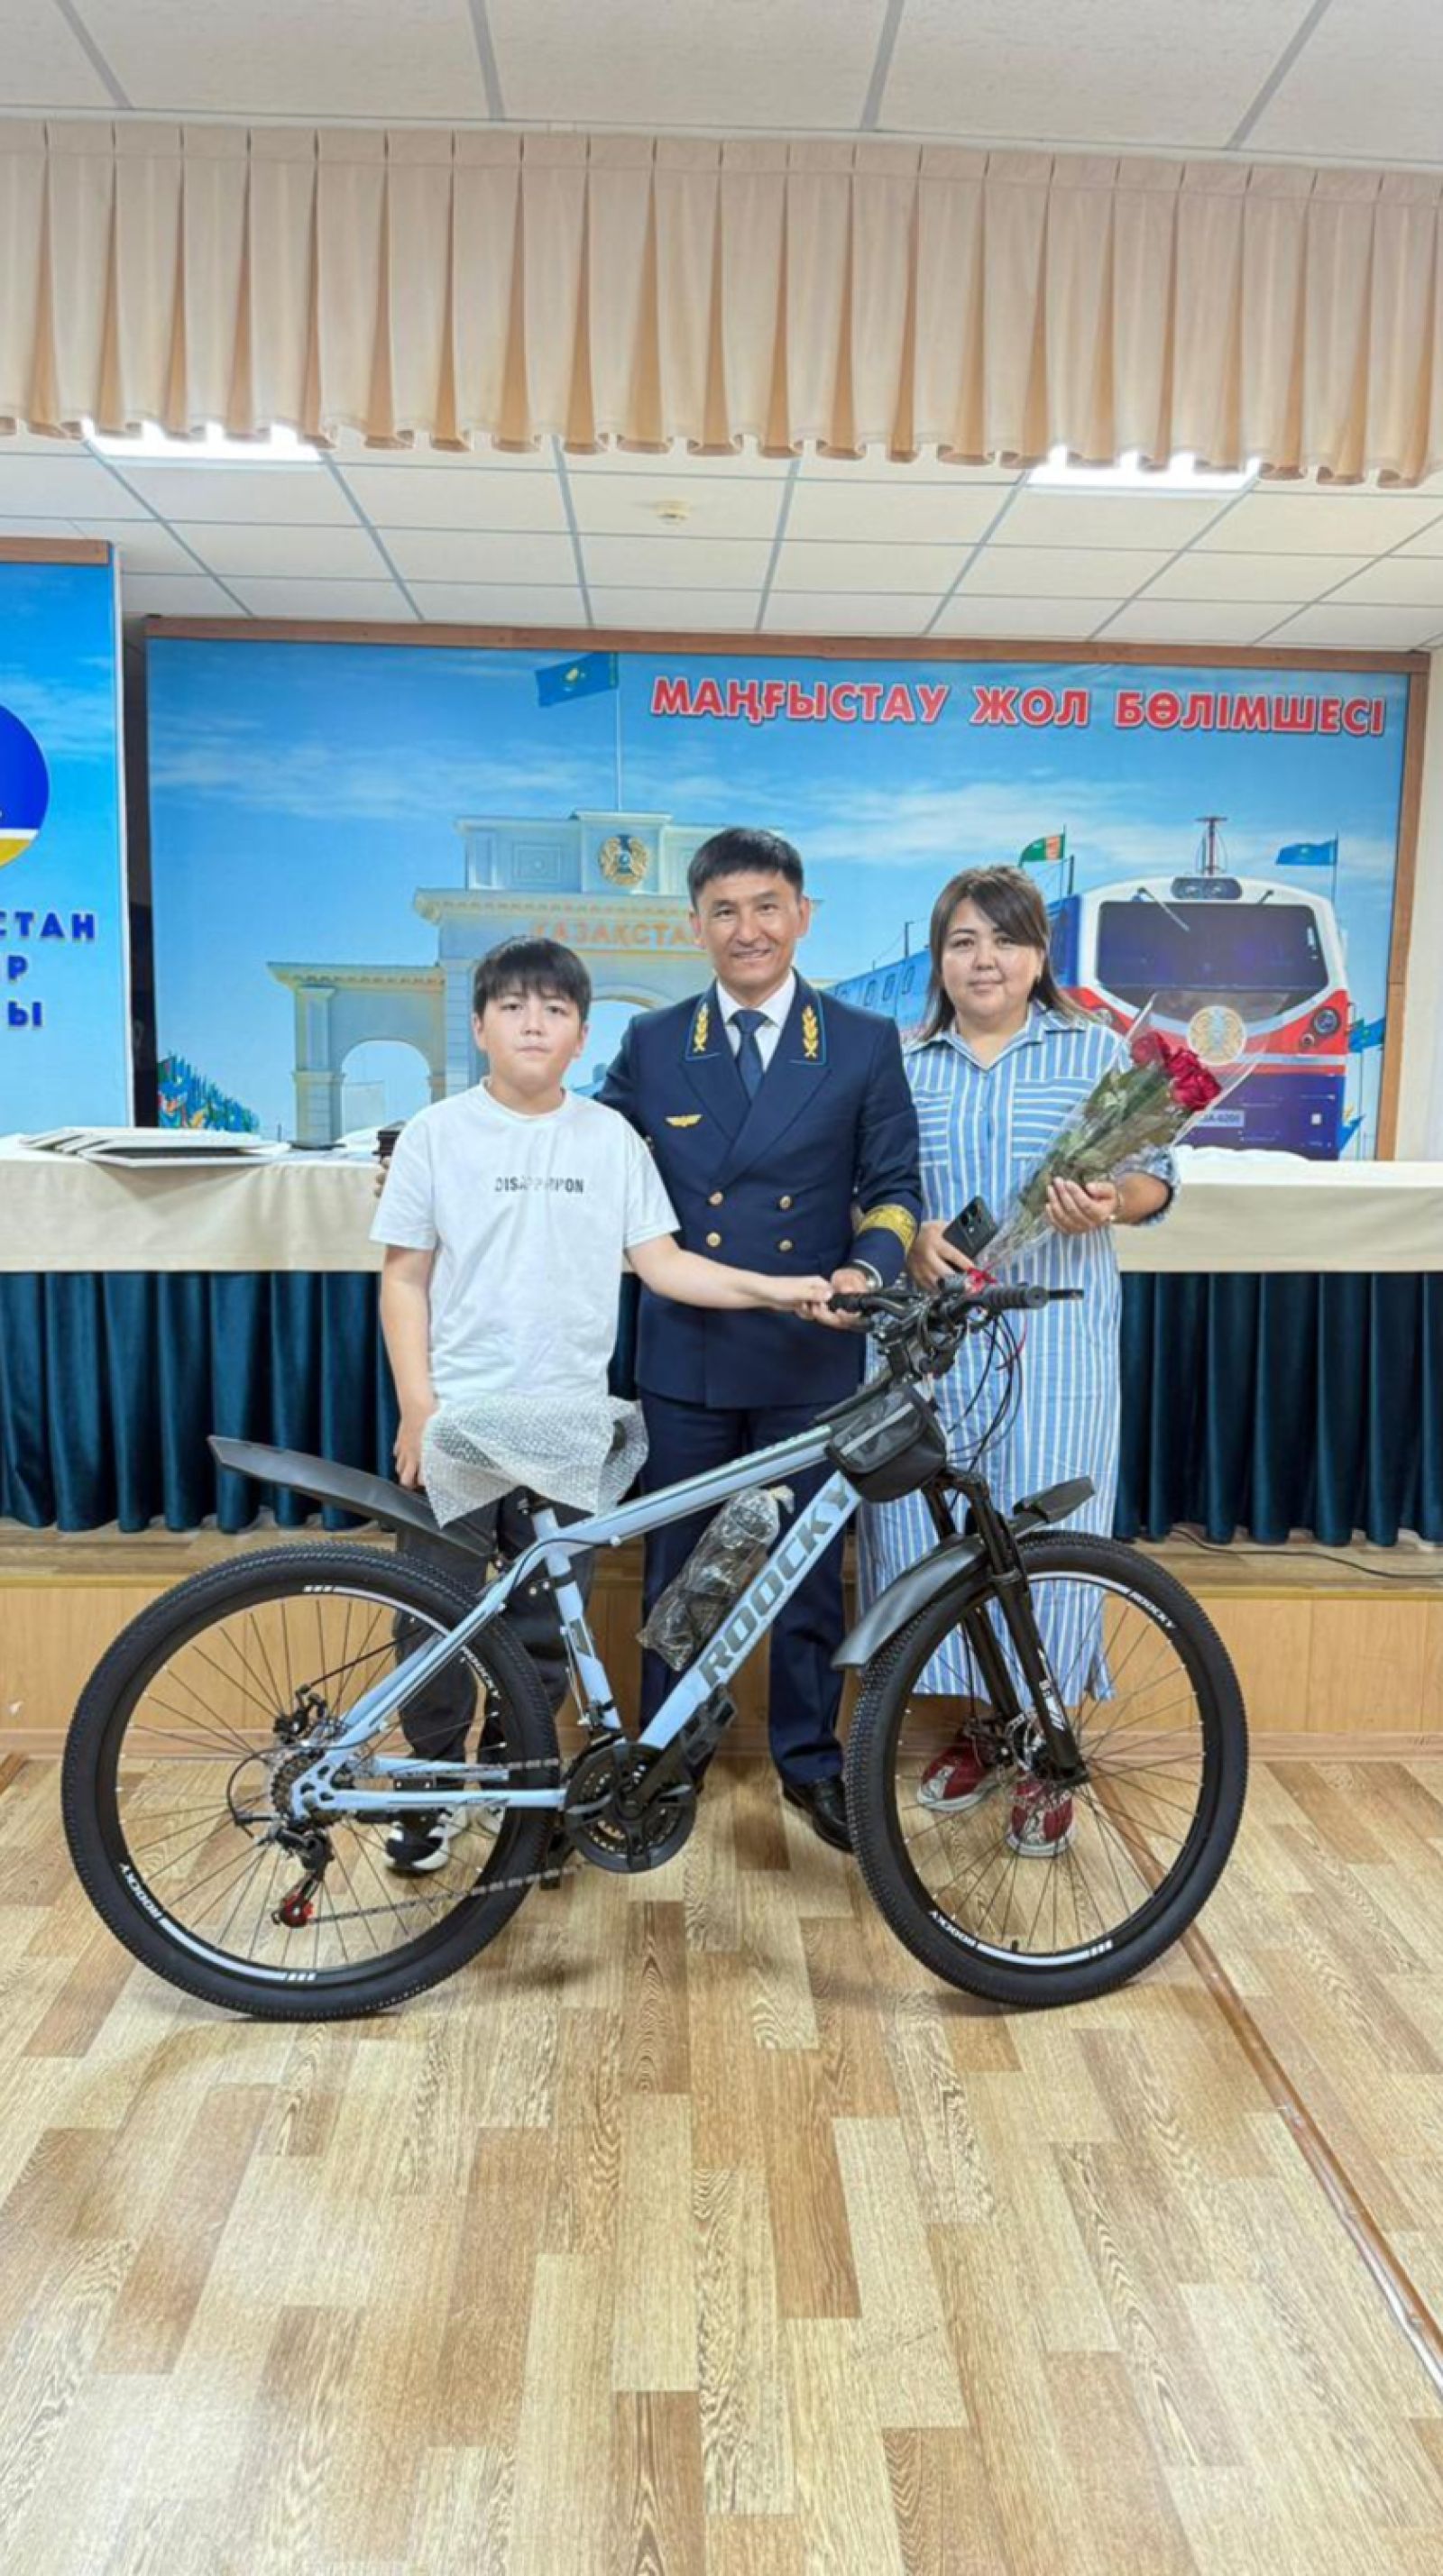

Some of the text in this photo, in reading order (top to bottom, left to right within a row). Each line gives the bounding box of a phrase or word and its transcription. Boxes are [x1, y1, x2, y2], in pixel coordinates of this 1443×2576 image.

[651, 676, 1385, 735] МАҢҒЫСТАУ ЖОЛ БӨЛІМШЕСІ
[699, 1483, 850, 1689] ROOCKY
